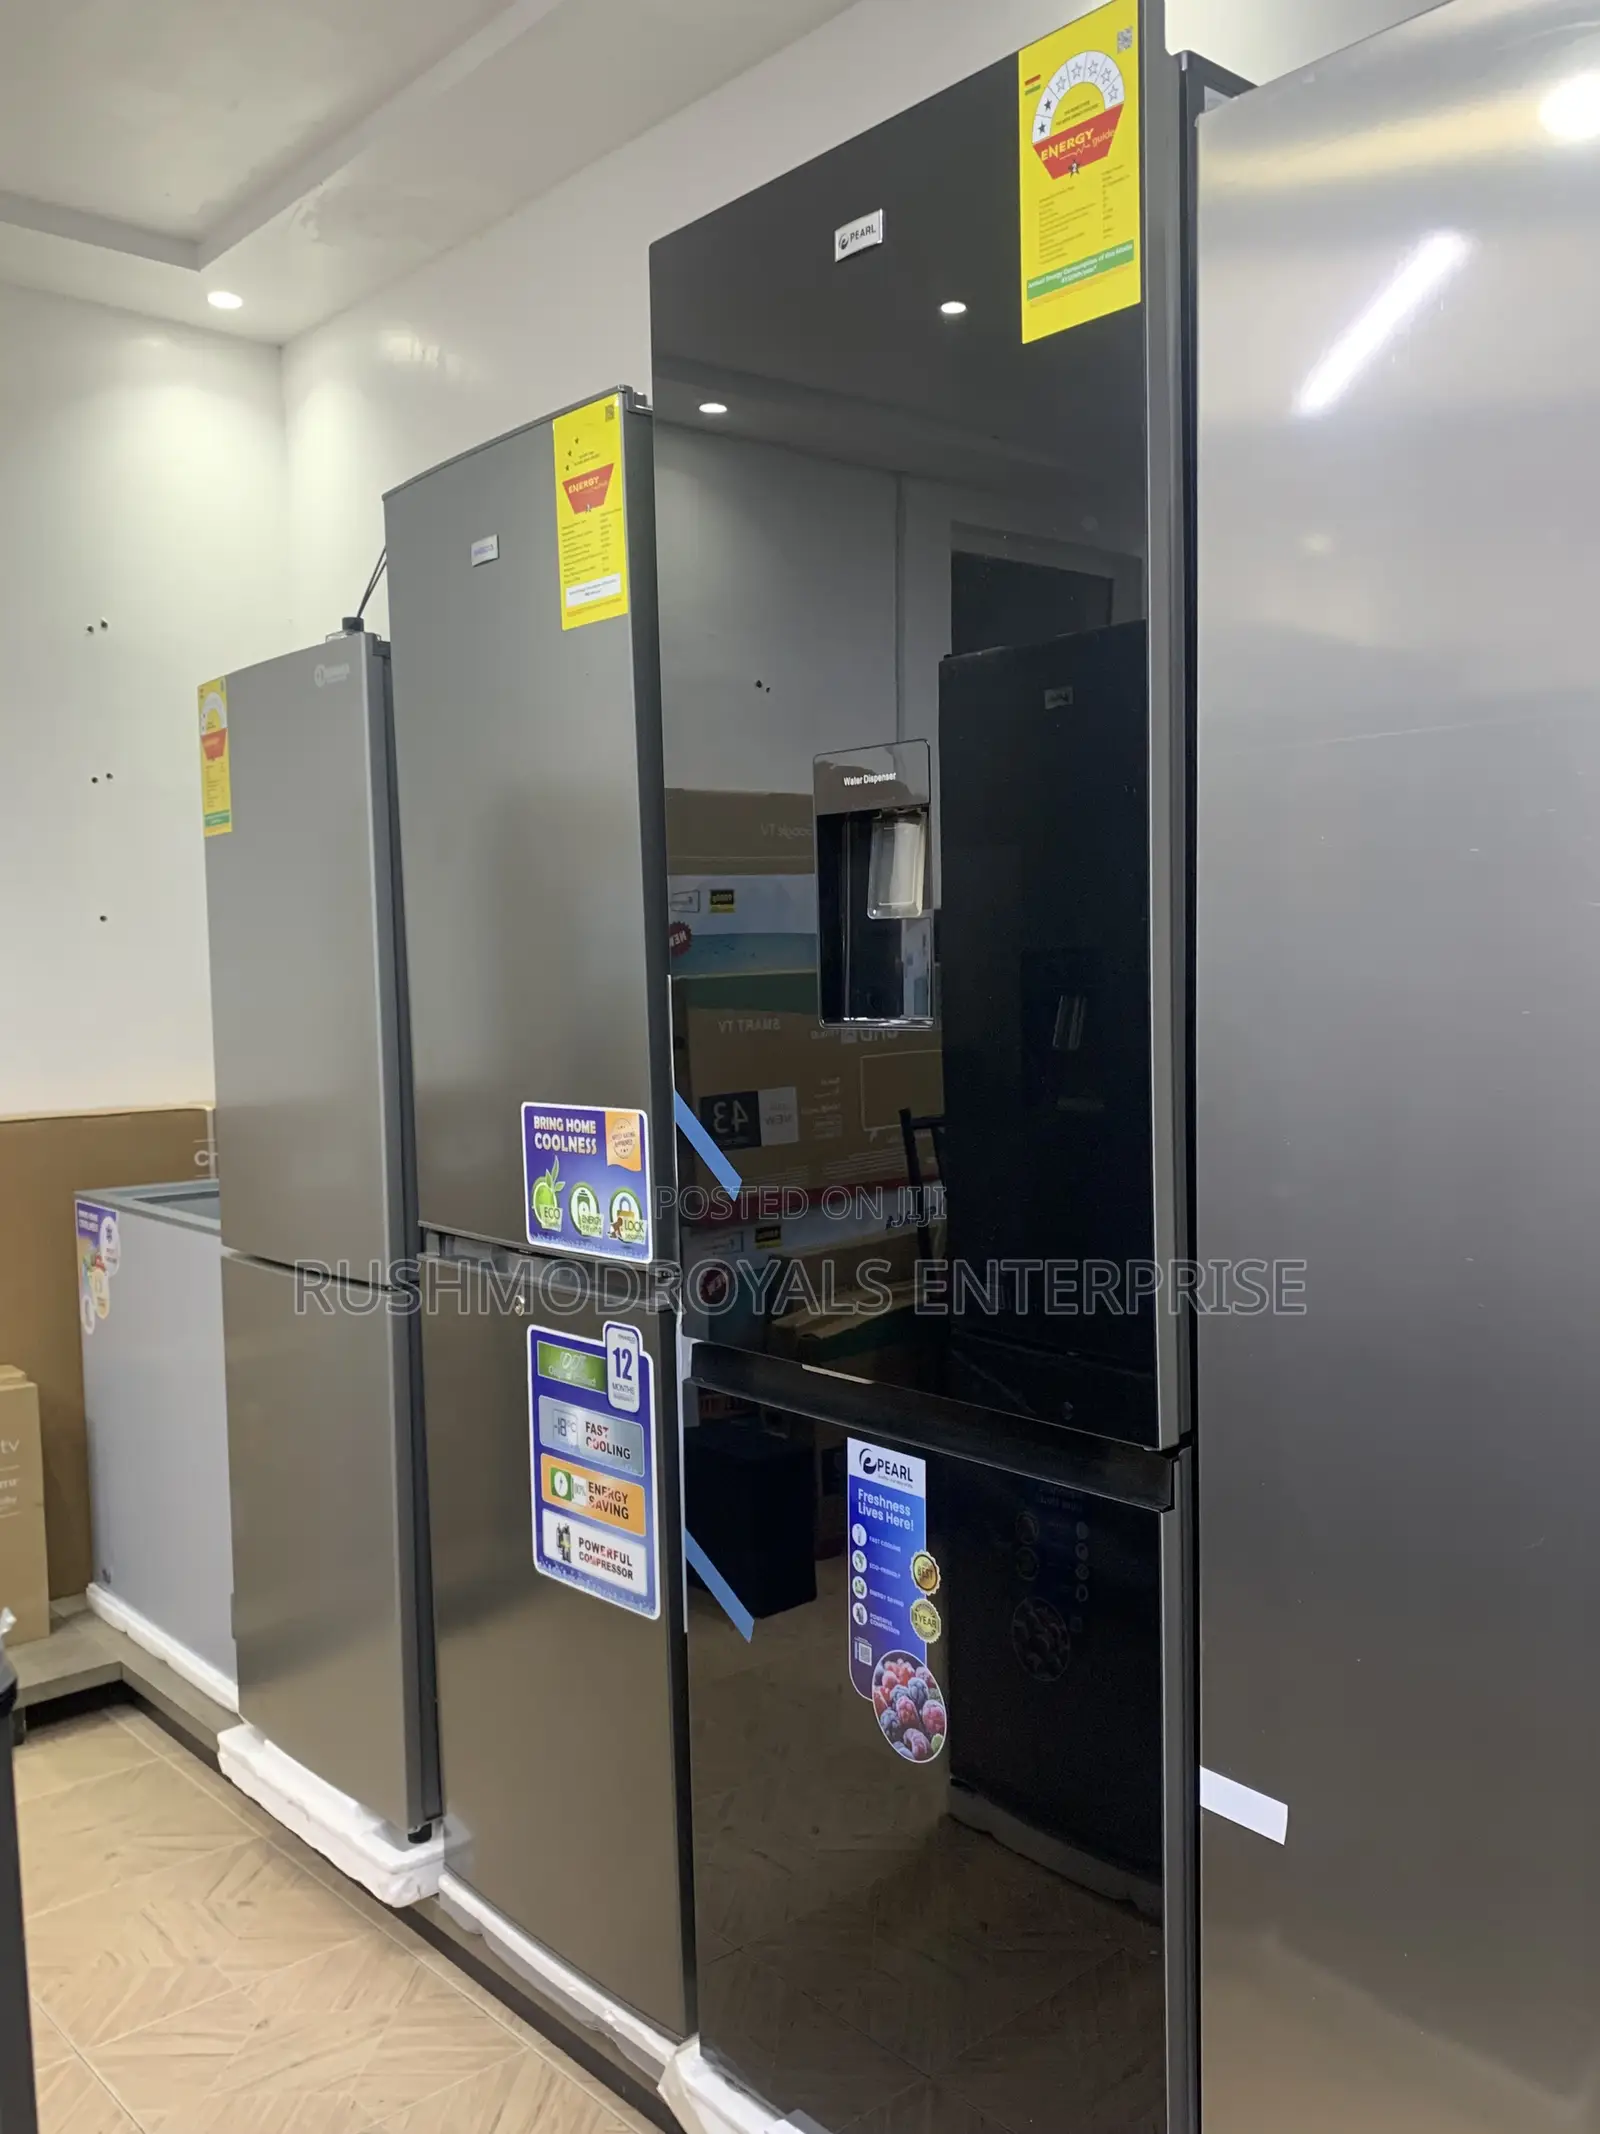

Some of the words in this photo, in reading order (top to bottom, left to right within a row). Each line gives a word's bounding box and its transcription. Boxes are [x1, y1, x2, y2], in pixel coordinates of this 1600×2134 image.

[1041, 128, 1094, 161] ENERGY
[850, 223, 877, 243] PEARL
[568, 475, 600, 494] ENERGY
[843, 775, 863, 786] Water
[863, 772, 897, 785] Dispenser
[533, 1115, 564, 1131] BRING
[566, 1118, 597, 1134] HOME
[534, 1132, 597, 1155] COOLNESS
[544, 1207, 560, 1220] ECO
[624, 1219, 645, 1233] LOCK
[612, 1346, 633, 1381] 12
[612, 1381, 636, 1396] MONTHS
[585, 1420, 609, 1439] FAST
[586, 1436, 631, 1460] COOLING
[877, 1458, 914, 1482] PEARL
[588, 1481, 629, 1505] ENERGY
[858, 1488, 911, 1516] Freshness
[588, 1495, 629, 1520] SAVING
[858, 1501, 884, 1521] Lives
[886, 1513, 915, 1532] Here!
[578, 1536, 633, 1567] POWERFUL
[578, 1551, 634, 1580] COMPRESSOR
[919, 1614, 937, 1629] YEAR
